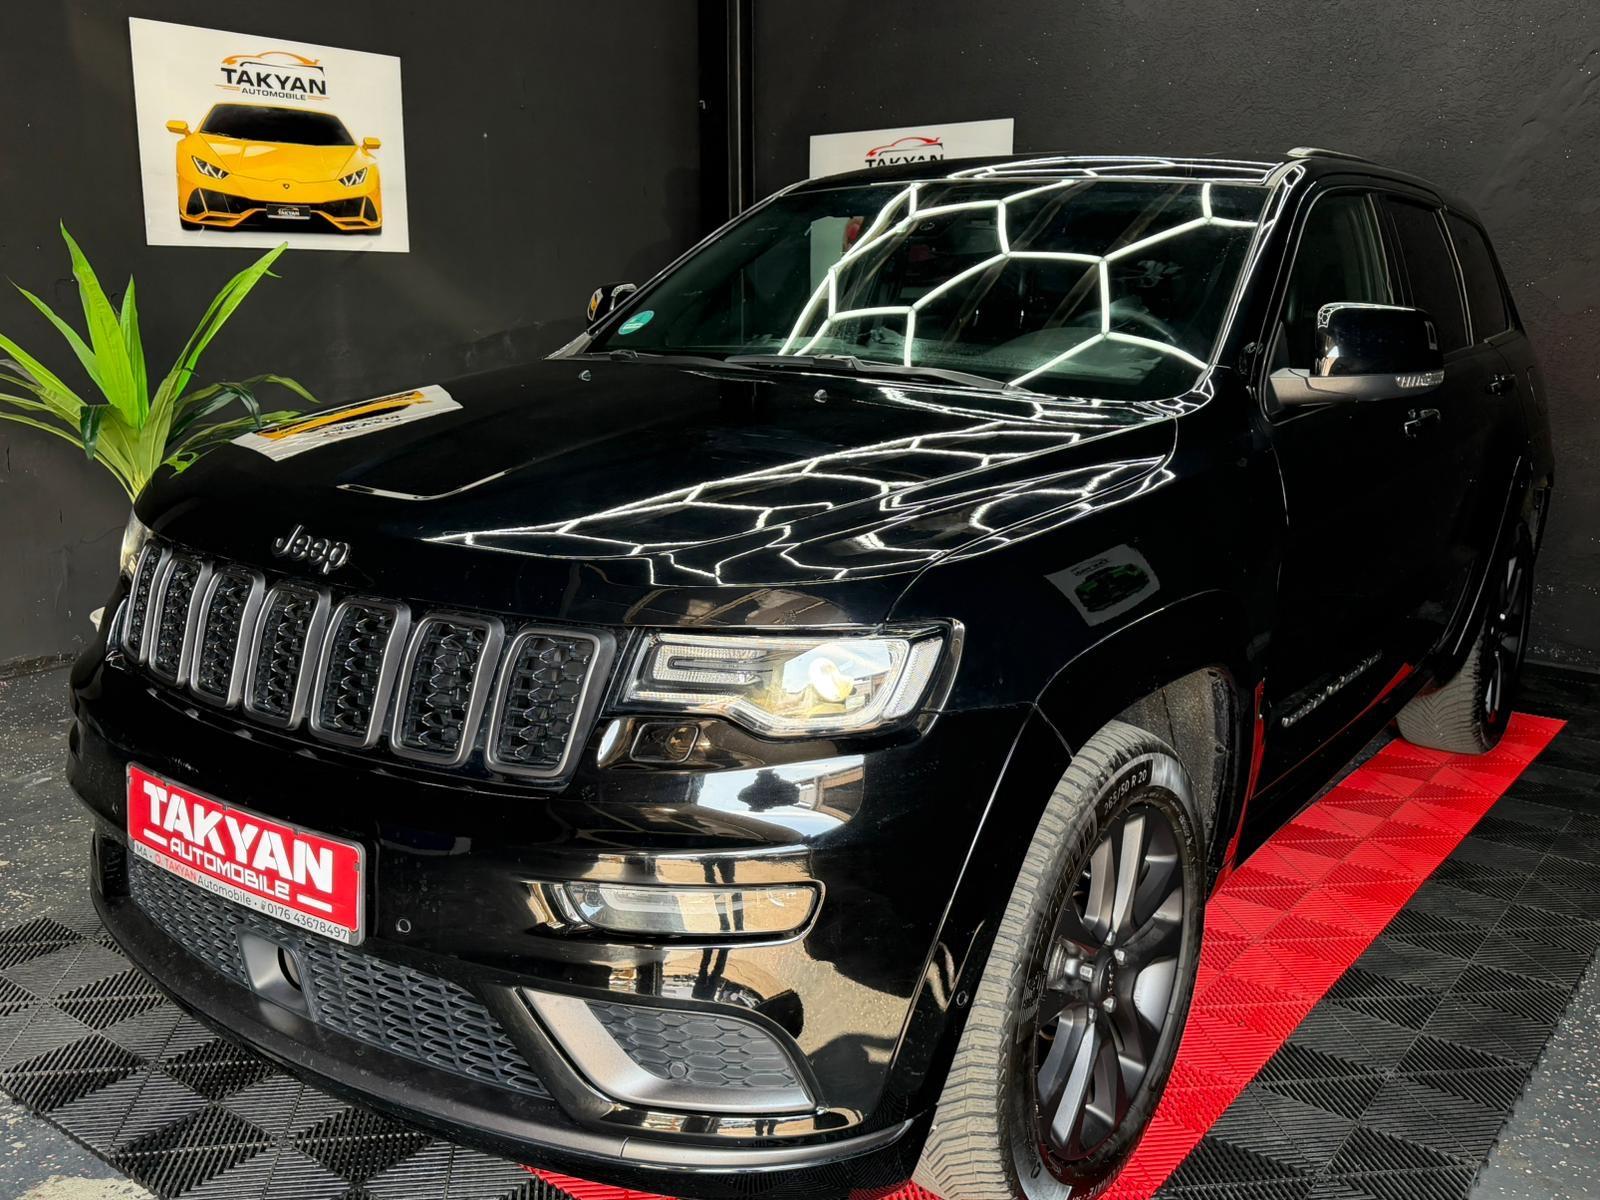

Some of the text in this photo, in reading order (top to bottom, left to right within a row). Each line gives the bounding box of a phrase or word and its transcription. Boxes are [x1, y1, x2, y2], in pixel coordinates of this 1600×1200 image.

[221, 67, 326, 95] TAKYAN
[242, 87, 306, 101] AUTOMOBILE
[272, 524, 350, 575] Jeep
[1104, 779, 1130, 816] 265/50
[1131, 774, 1137, 788] R
[1138, 769, 1148, 784] 20
[143, 780, 334, 895] TAKYAN
[170, 837, 291, 901] AUTOMOBILE
[165, 858, 198, 881] TAKYAN
[198, 875, 252, 906] Automobile
[267, 903, 291, 920] 0176
[293, 912, 348, 940] 43678497
